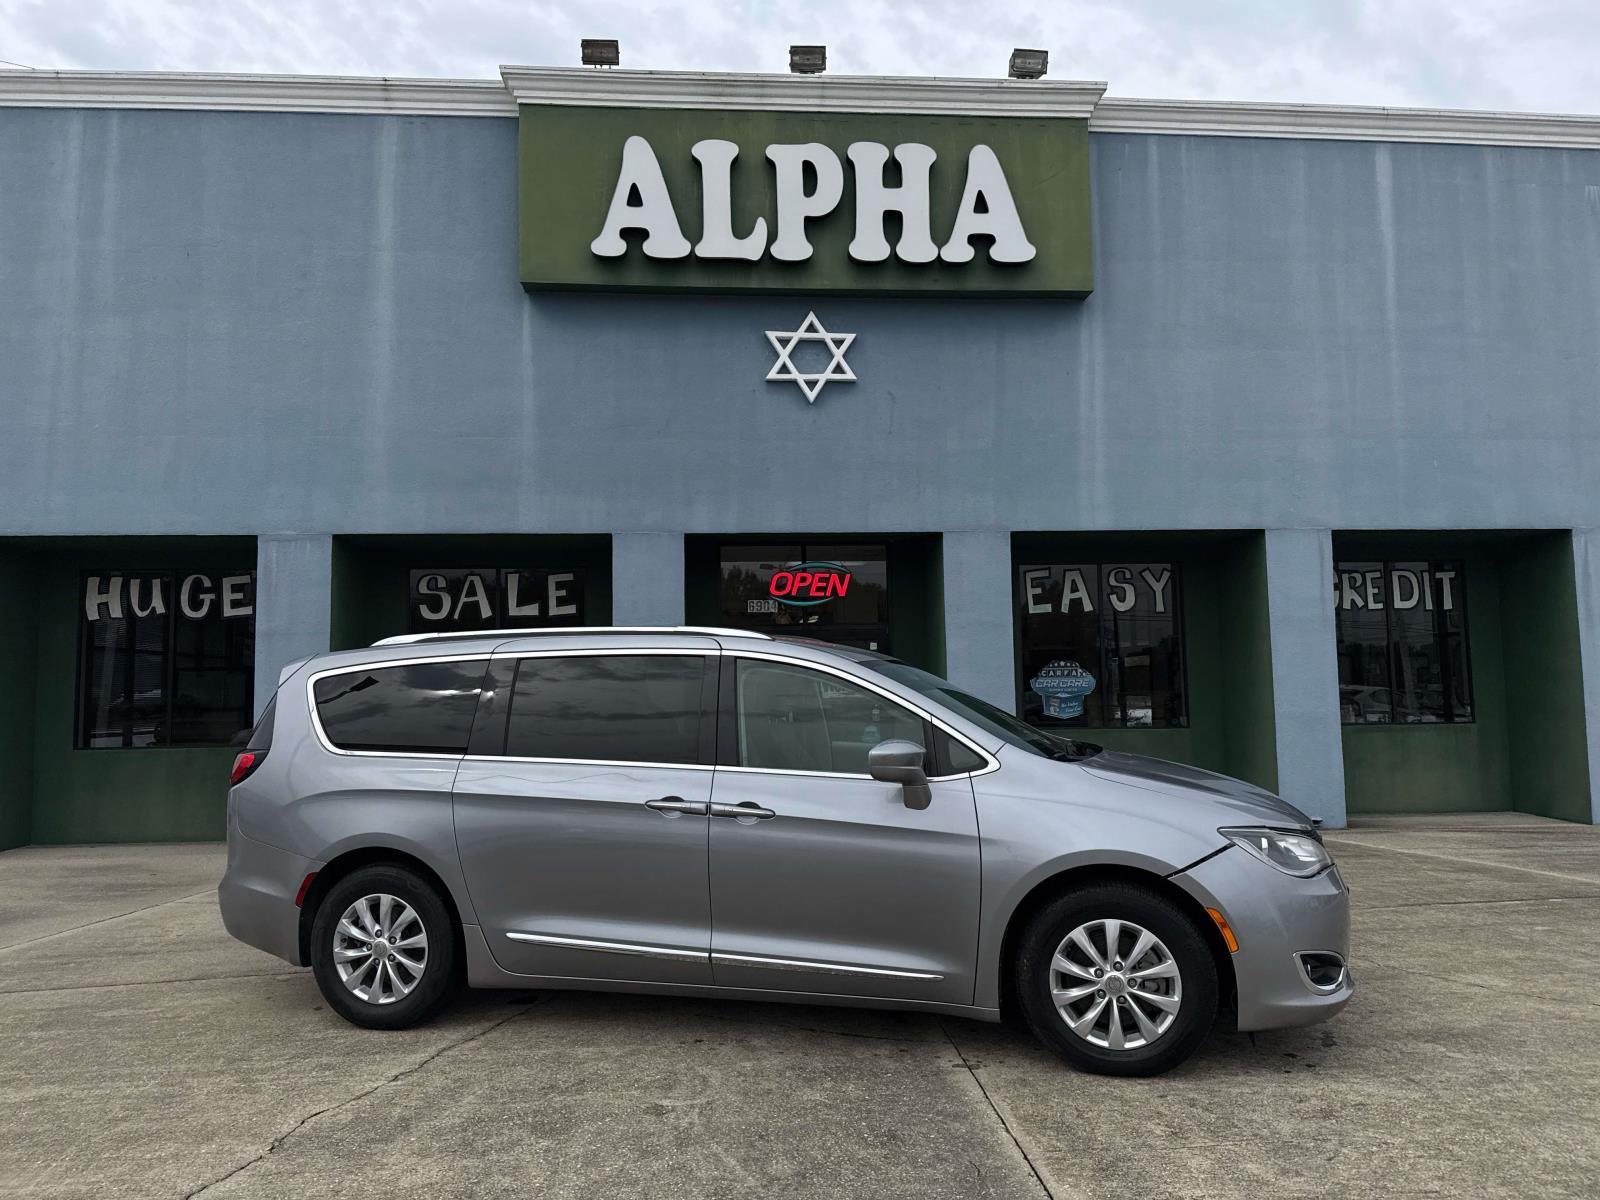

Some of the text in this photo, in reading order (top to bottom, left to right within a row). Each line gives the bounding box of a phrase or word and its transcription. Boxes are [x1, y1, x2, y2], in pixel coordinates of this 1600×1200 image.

[590, 135, 1037, 264] ALPHA
[85, 573, 254, 621] HUGE
[418, 572, 578, 621] SALE
[769, 571, 852, 598] OPEN
[1025, 566, 1173, 615] EASY
[1035, 679, 1089, 688] CAR CARE
